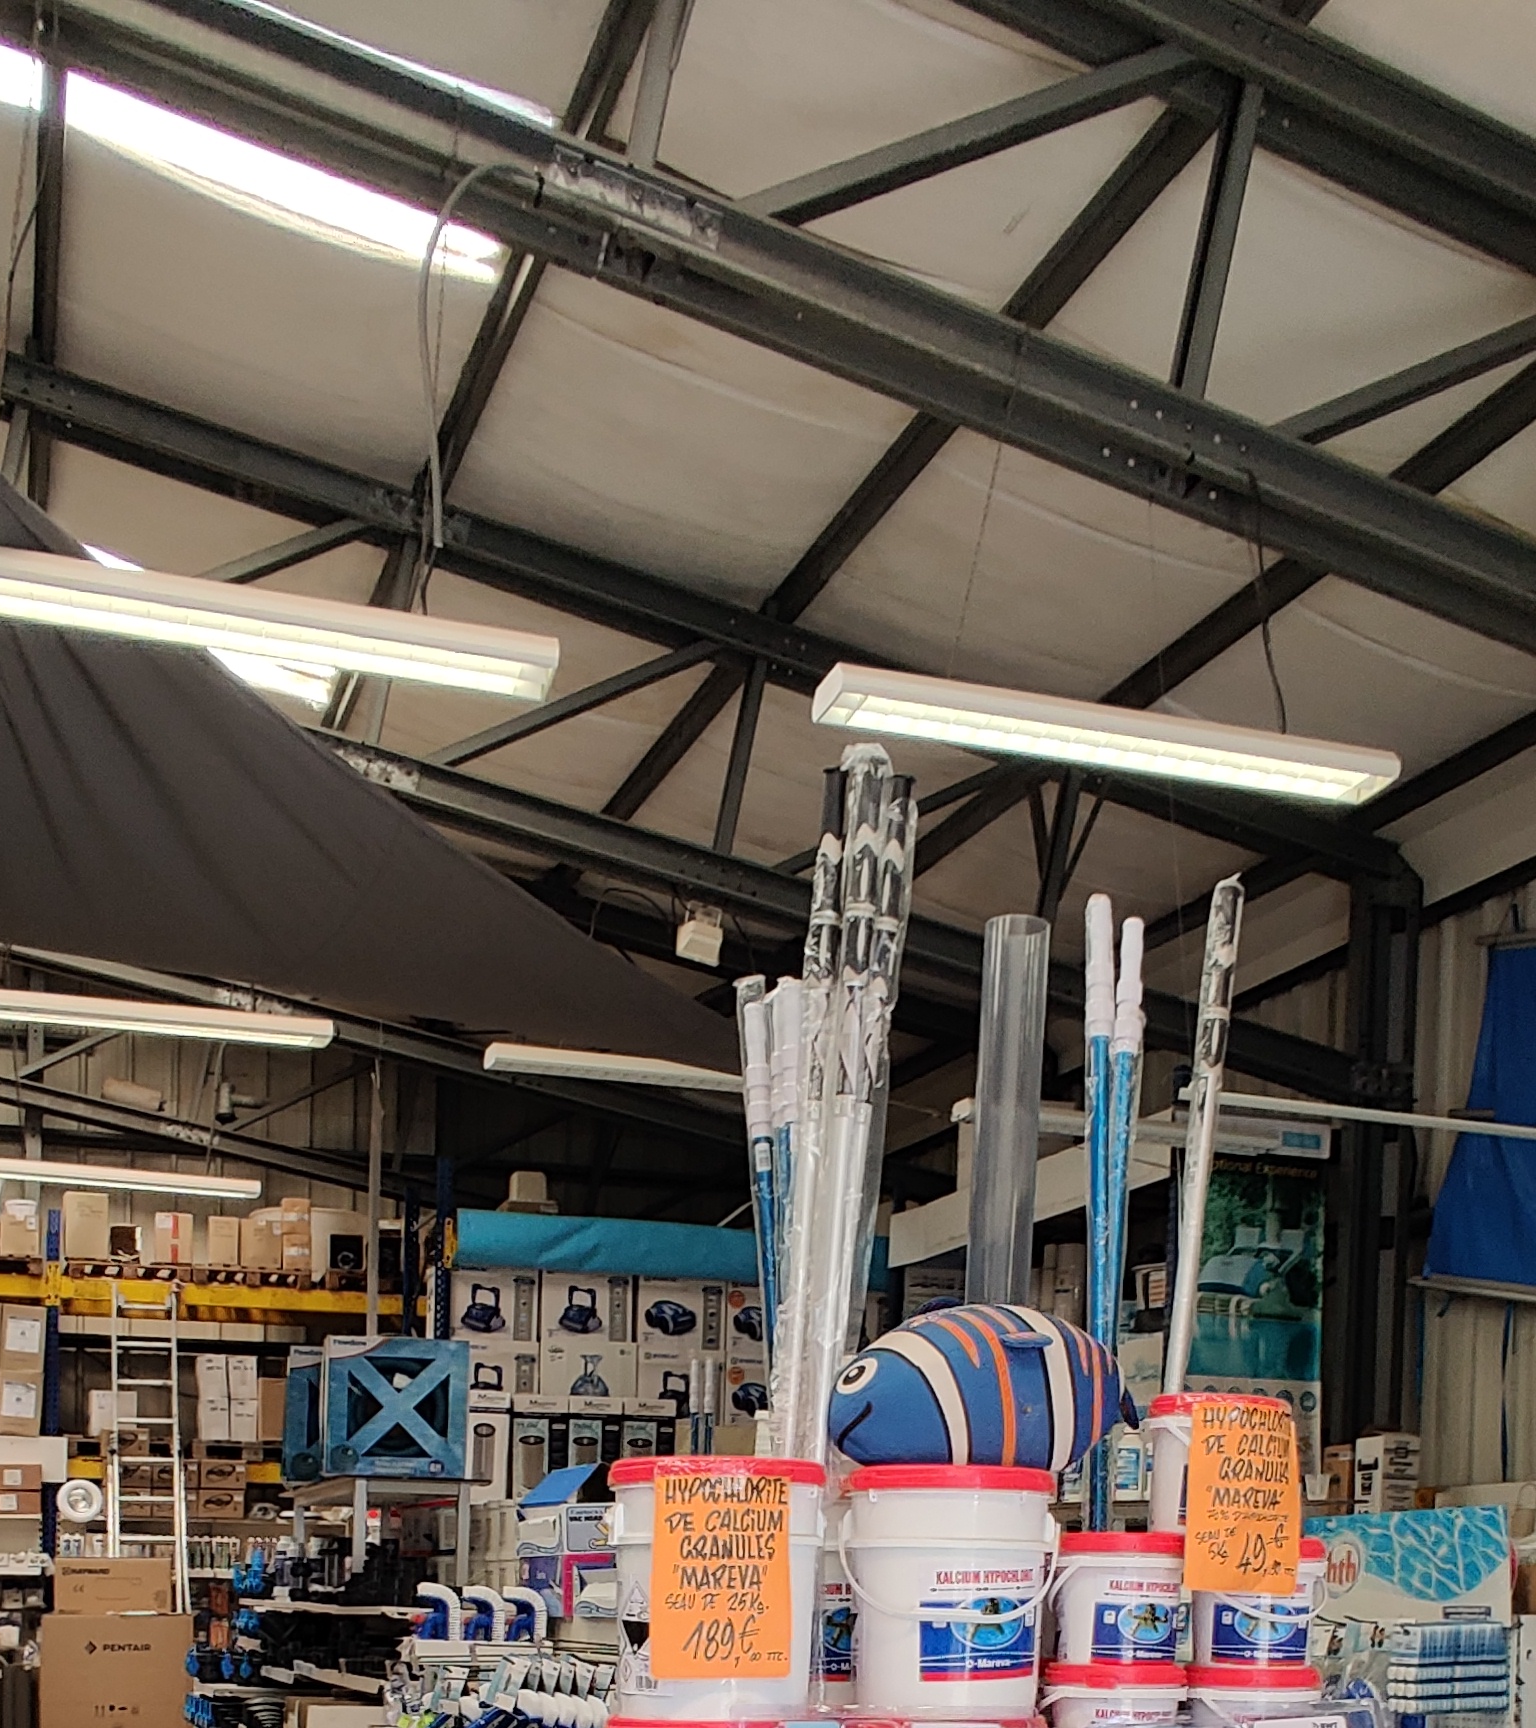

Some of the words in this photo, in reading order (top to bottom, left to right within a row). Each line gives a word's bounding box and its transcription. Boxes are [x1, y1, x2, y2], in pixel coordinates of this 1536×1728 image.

[1201, 1434, 1227, 1456] DE
[664, 1511, 696, 1534] DE
[680, 1533, 776, 1561] GRANULES
[1326, 1550, 1357, 1586] hth
[936, 1570, 981, 1585] KALCIUM
[1109, 1580, 1144, 1592] KALCIUM
[664, 1593, 696, 1611] SEAU
[701, 1593, 721, 1611] DE
[102, 1643, 151, 1652] PENTAIR
[977, 1658, 1012, 1669] Mareva
